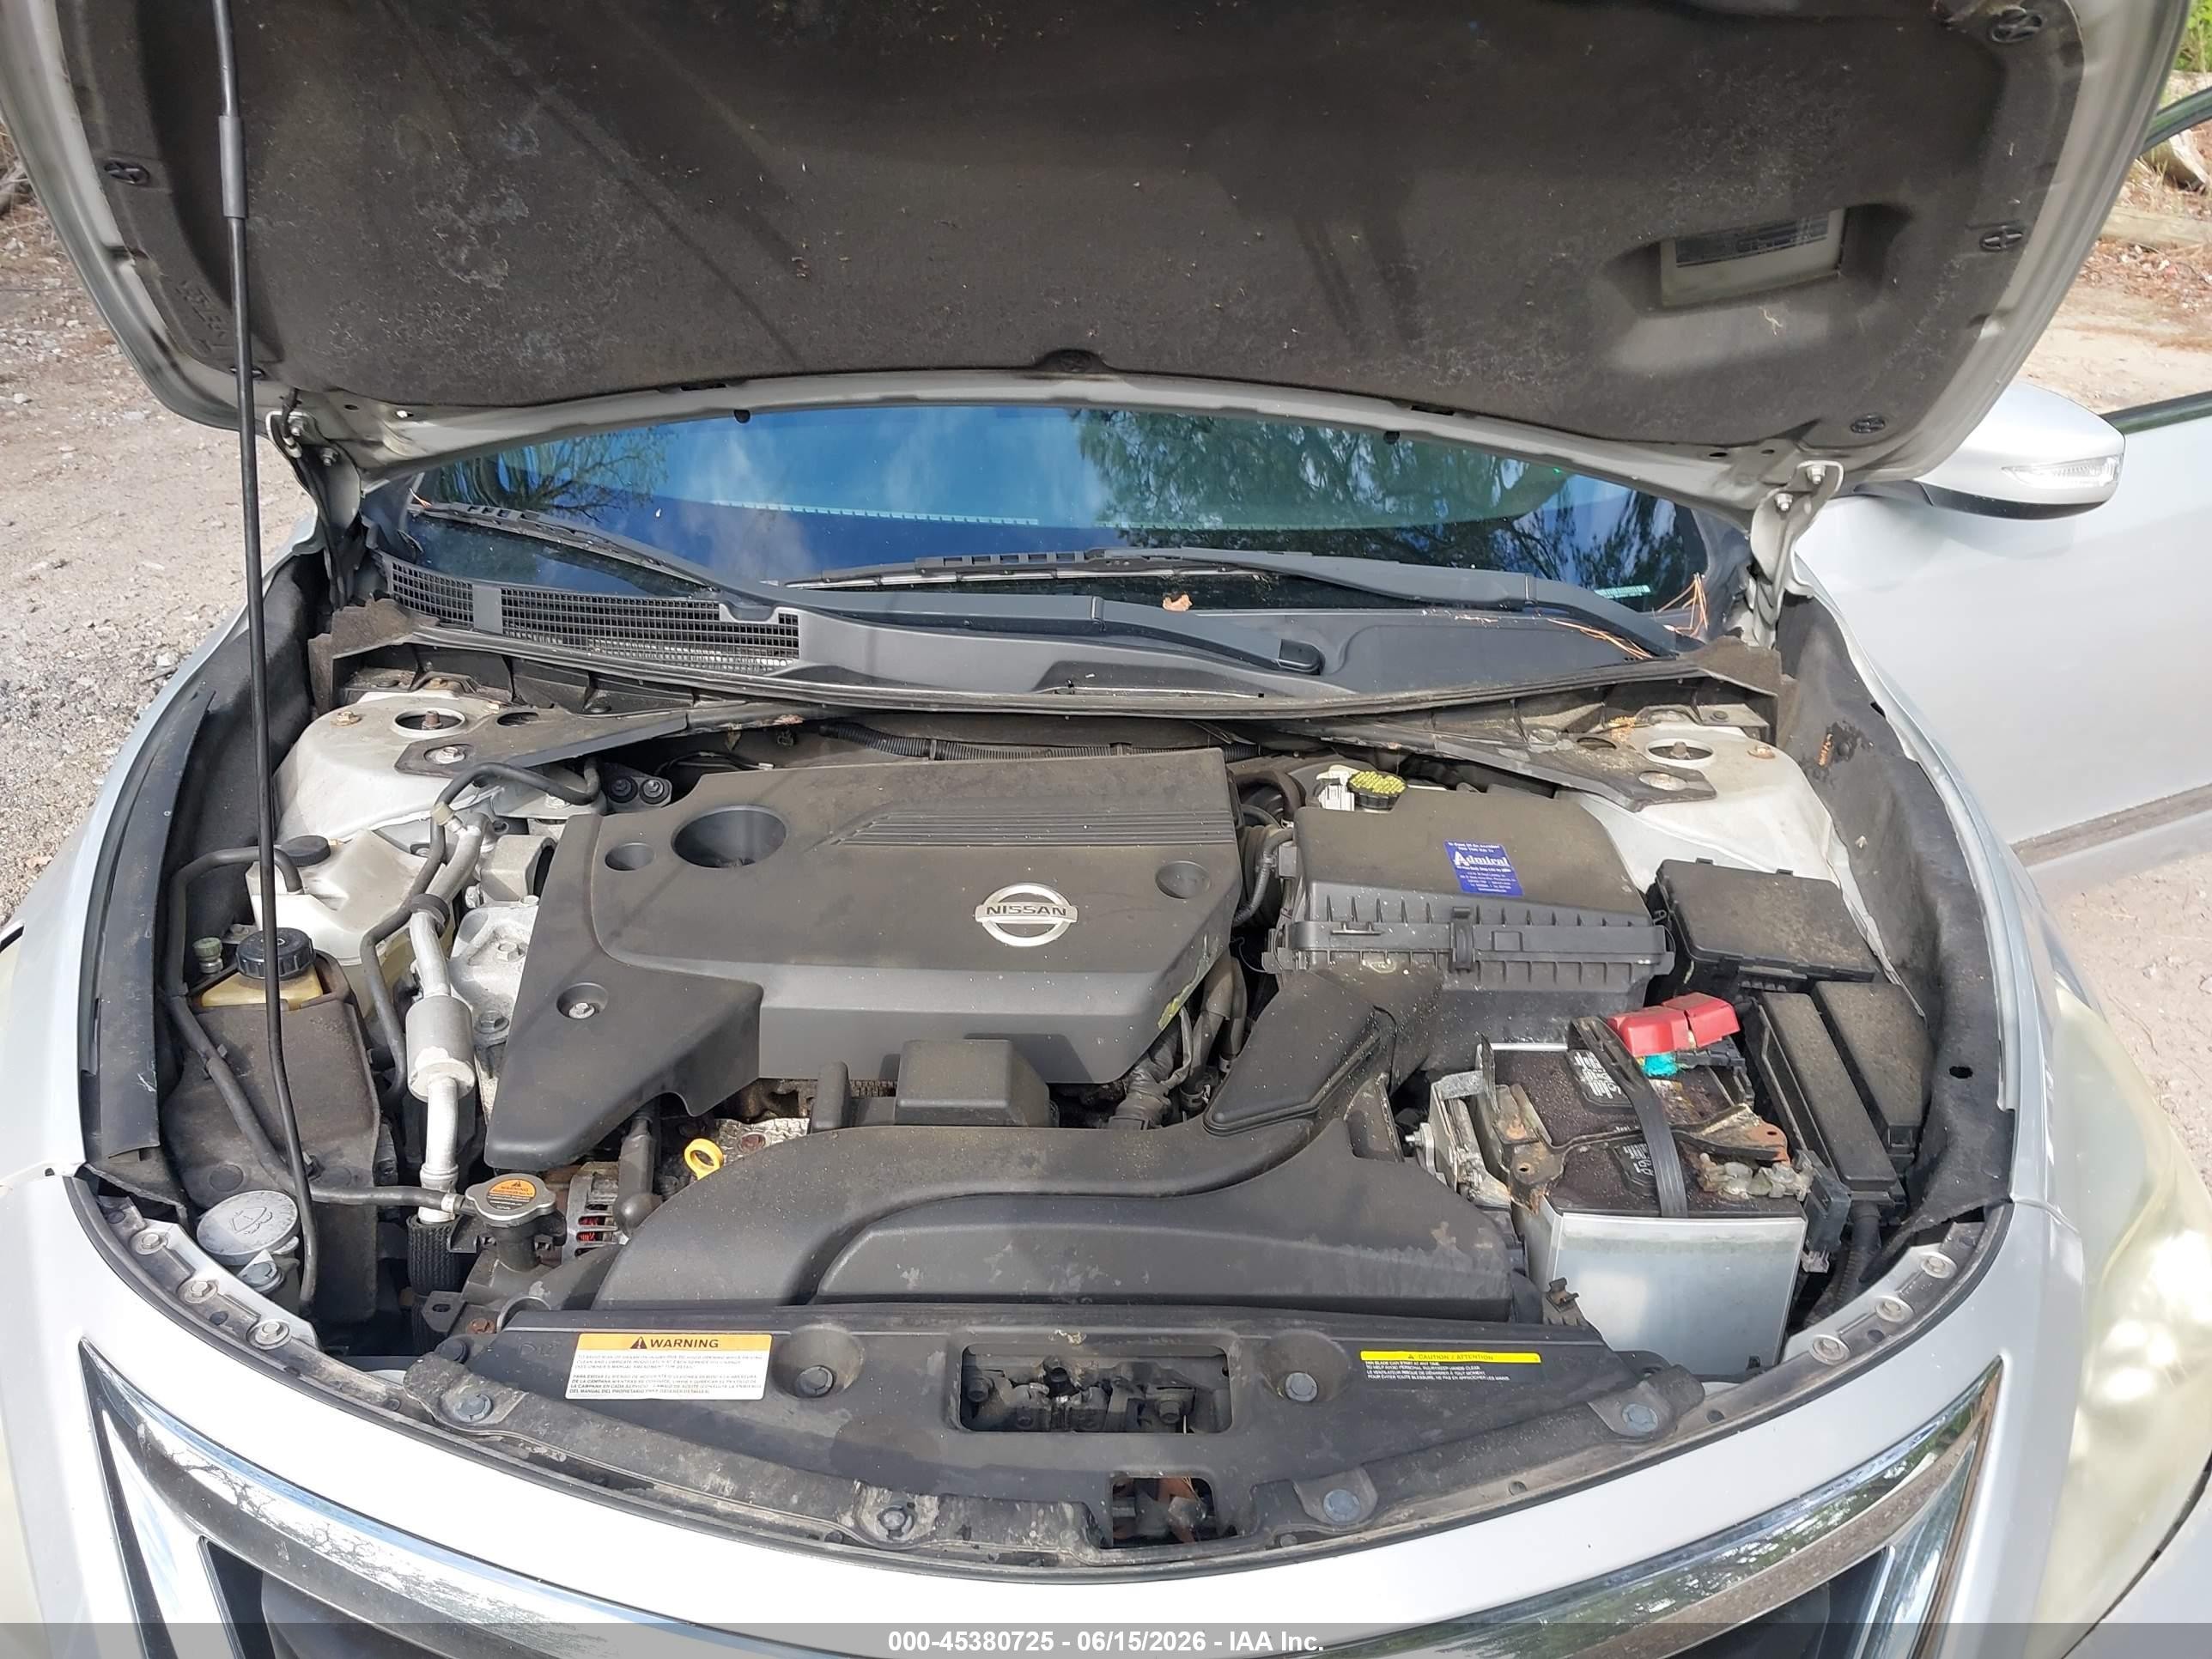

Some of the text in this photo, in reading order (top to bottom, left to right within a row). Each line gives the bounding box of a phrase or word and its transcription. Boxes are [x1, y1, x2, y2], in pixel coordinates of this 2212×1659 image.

[1454, 851, 1510, 867] Admiral
[986, 905, 1066, 916] NISSAN
[650, 1339, 720, 1348] WARNING
